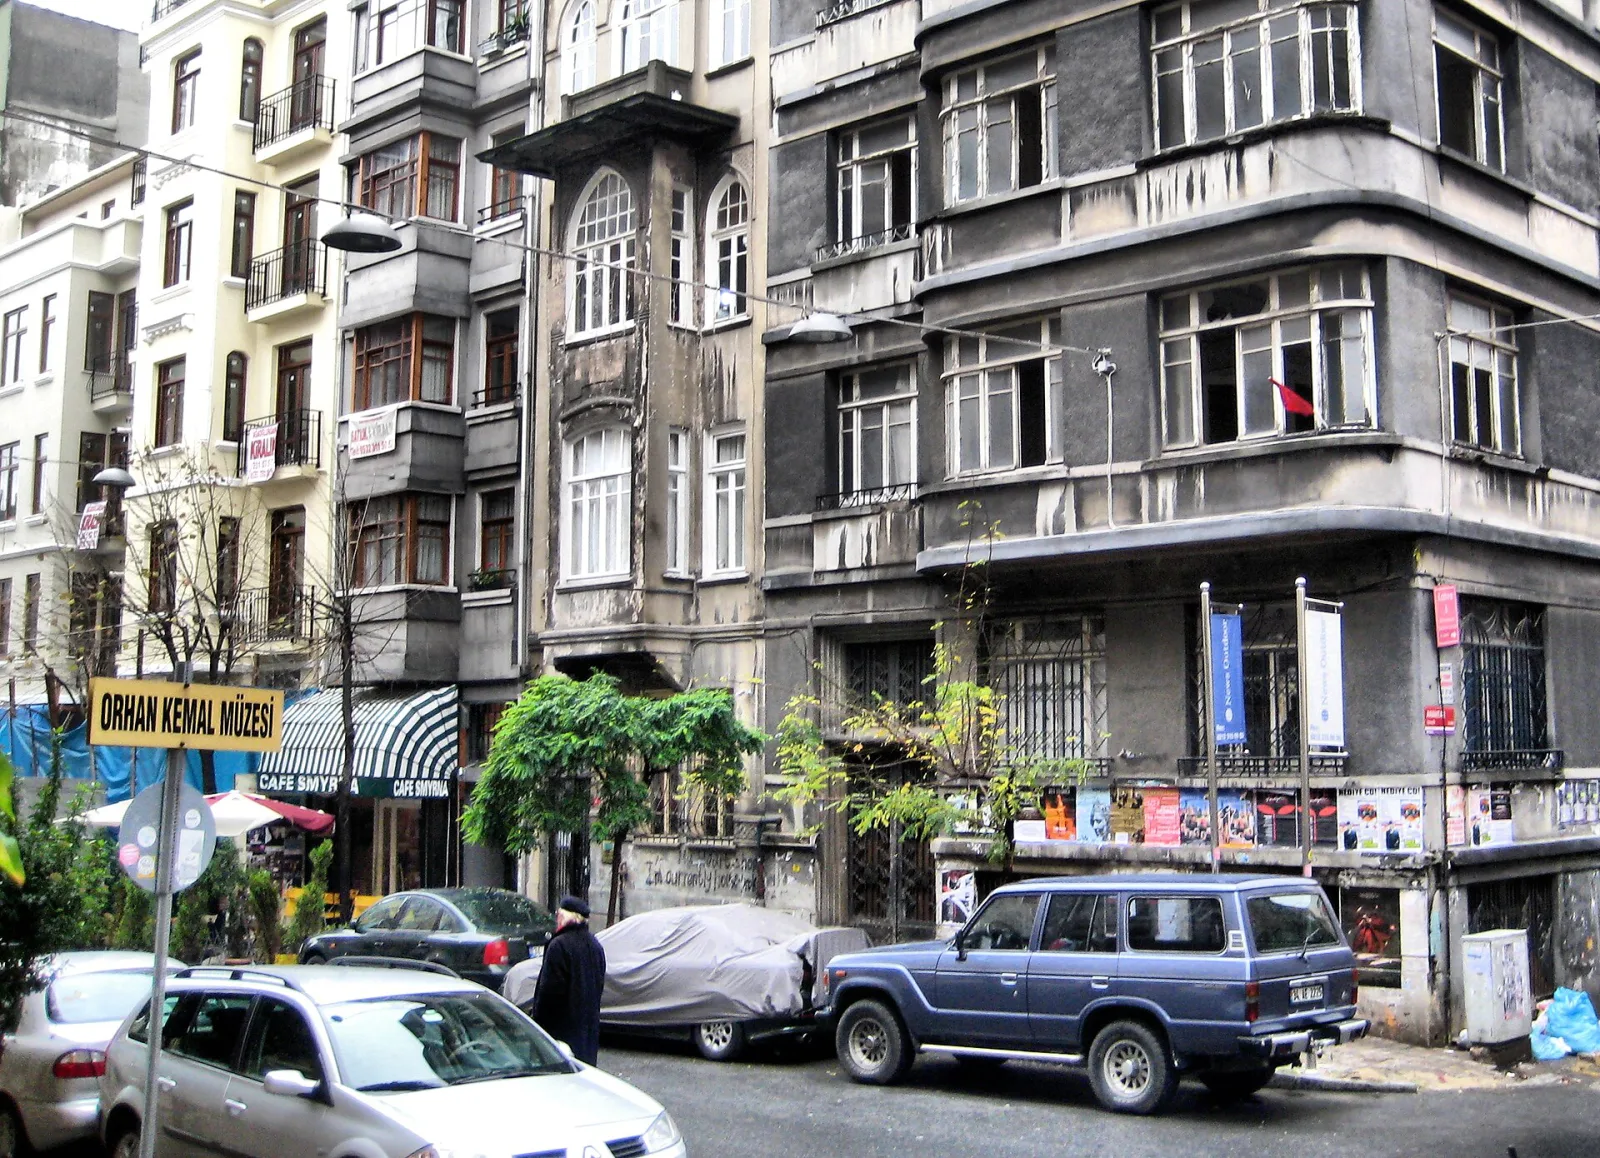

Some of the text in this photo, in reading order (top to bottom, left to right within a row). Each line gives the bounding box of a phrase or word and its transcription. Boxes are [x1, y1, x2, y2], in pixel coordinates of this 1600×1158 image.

[1222, 618, 1232, 706] News Outdoor
[1321, 672, 1329, 706] News
[101, 692, 275, 739] ORHAN KEMAL MÜZESİ
[259, 774, 360, 795] CAFE SMYRA
[393, 780, 449, 798] CAFE SMYRNA
